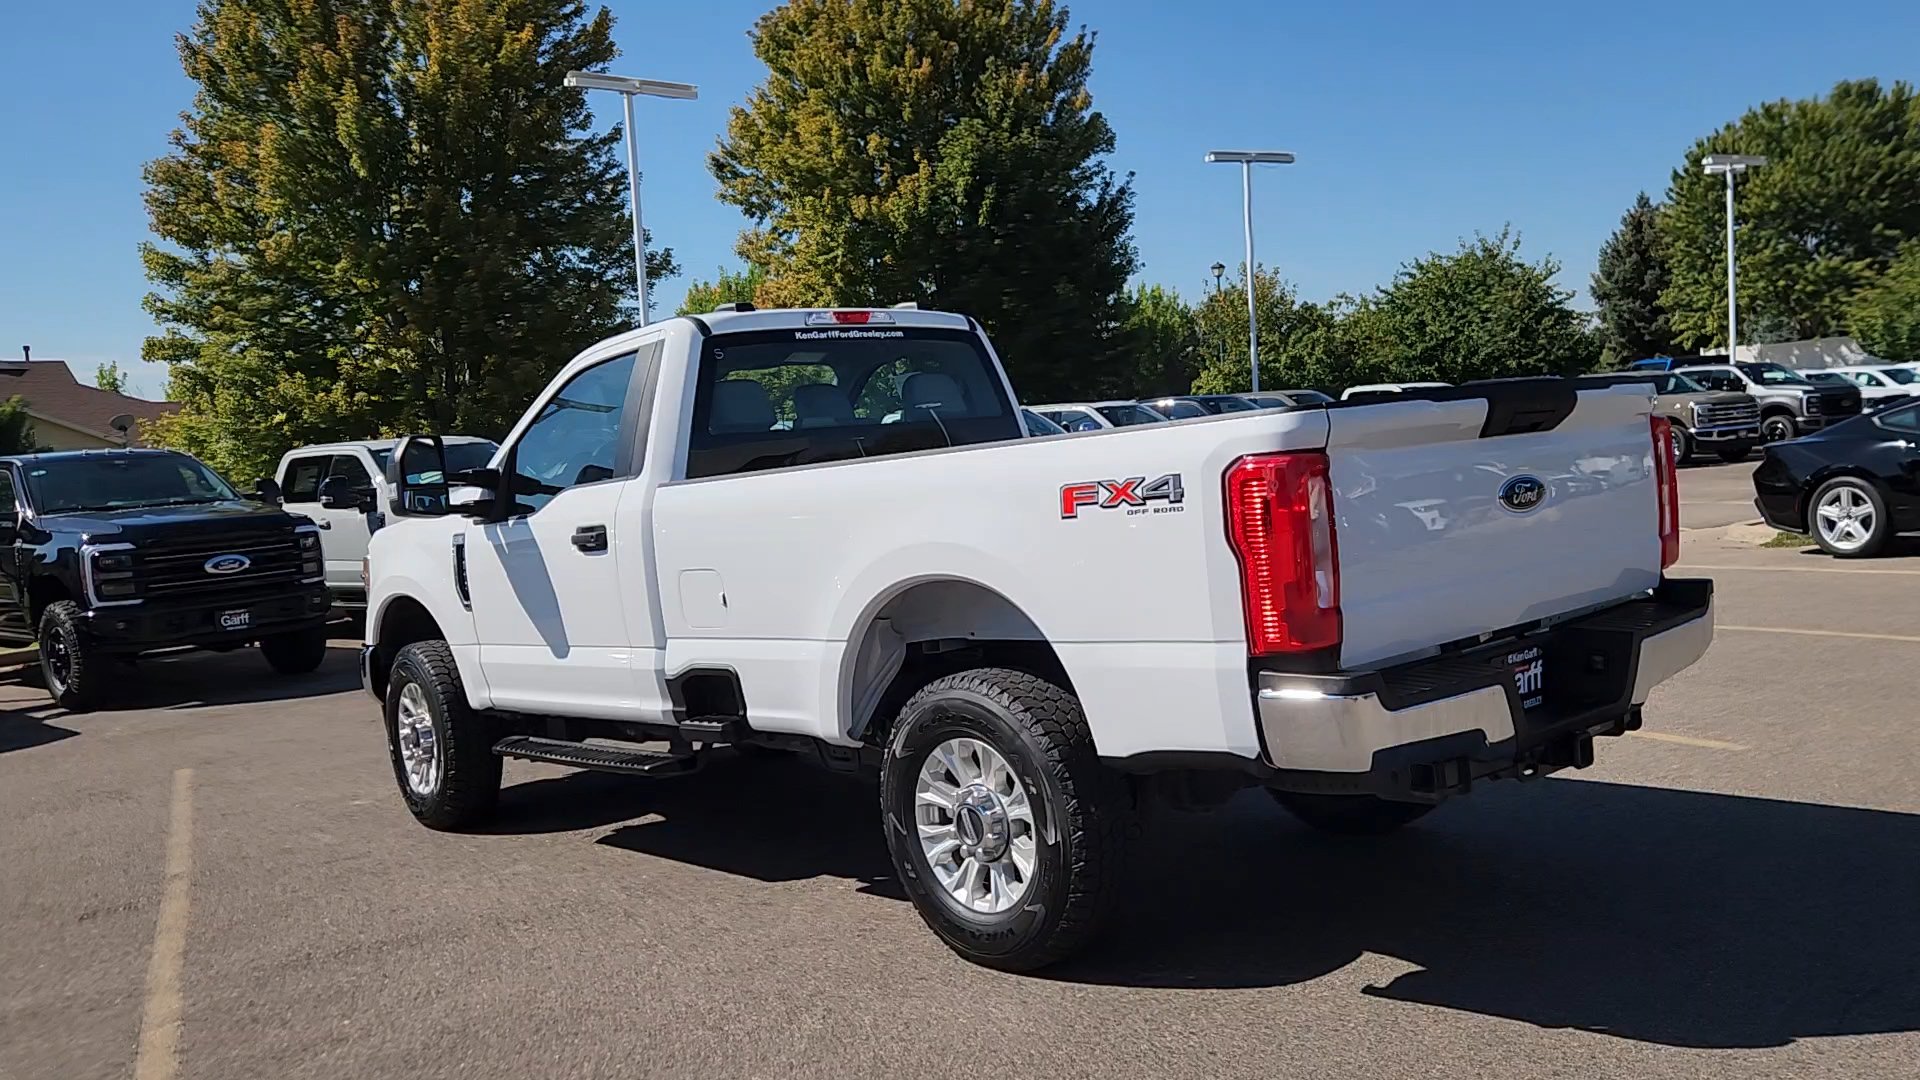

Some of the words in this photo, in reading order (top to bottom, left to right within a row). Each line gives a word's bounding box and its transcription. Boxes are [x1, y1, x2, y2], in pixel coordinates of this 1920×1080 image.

[795, 330, 904, 340] KenGarffFordGreeley.com
[1060, 473, 1184, 520] FX4
[1512, 483, 1539, 504] Ford
[1126, 508, 1150, 516] OFF
[1153, 506, 1185, 514] ROAD
[220, 612, 250, 627] Garff
[1514, 659, 1543, 694] arff
